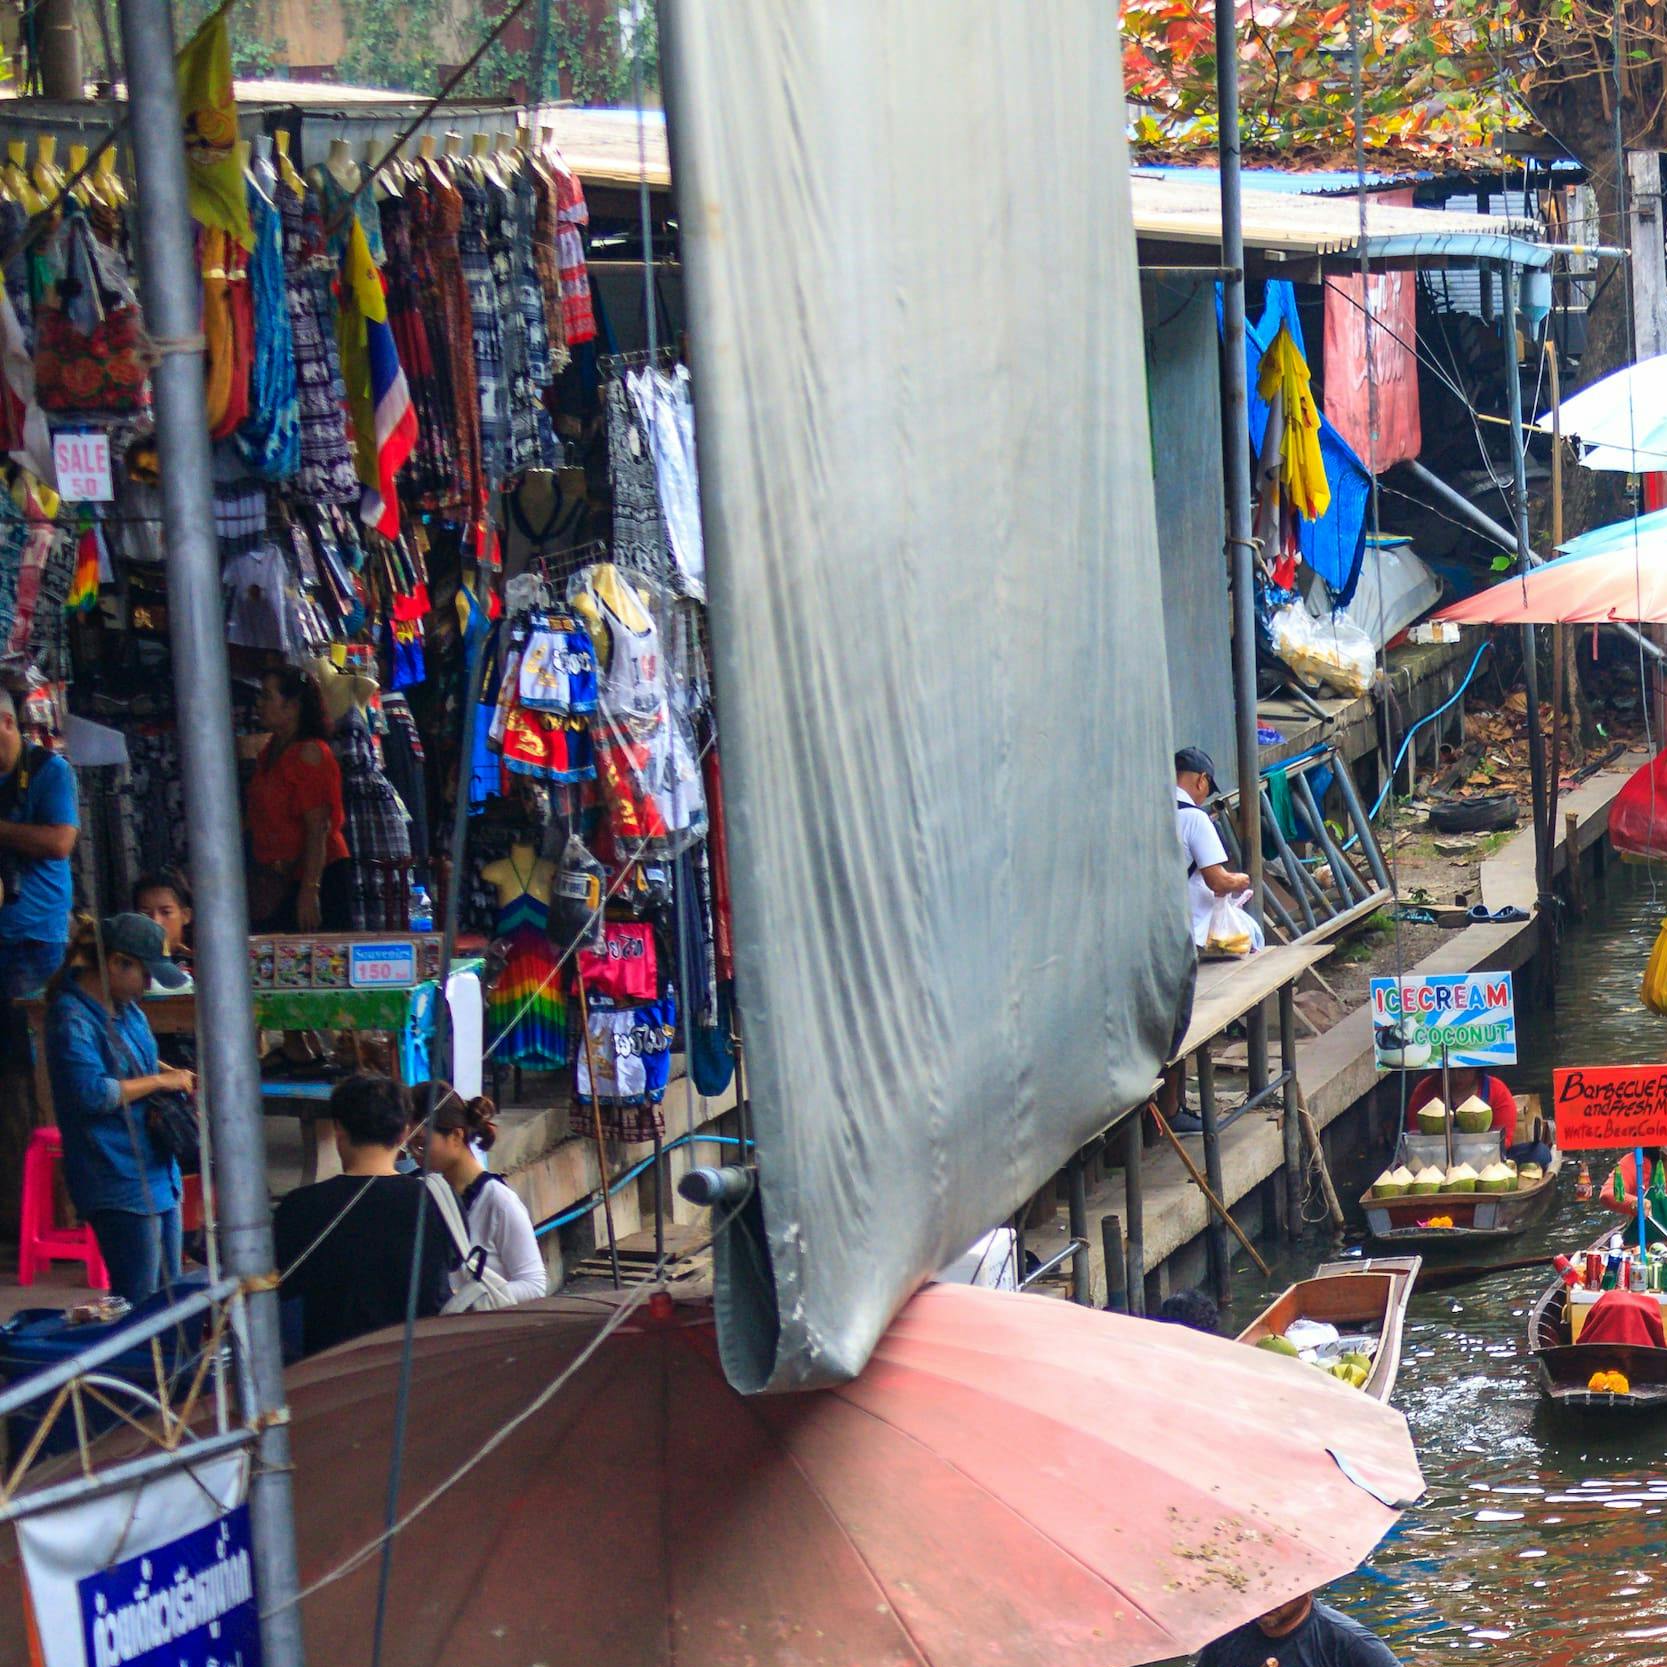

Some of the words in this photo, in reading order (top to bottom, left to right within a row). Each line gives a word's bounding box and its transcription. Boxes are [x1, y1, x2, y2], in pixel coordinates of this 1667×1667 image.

[58, 443, 106, 474] SALE
[358, 963, 392, 980] 150
[1375, 983, 1508, 1012] ICECREAM
[1414, 1024, 1508, 1045] COCONUT
